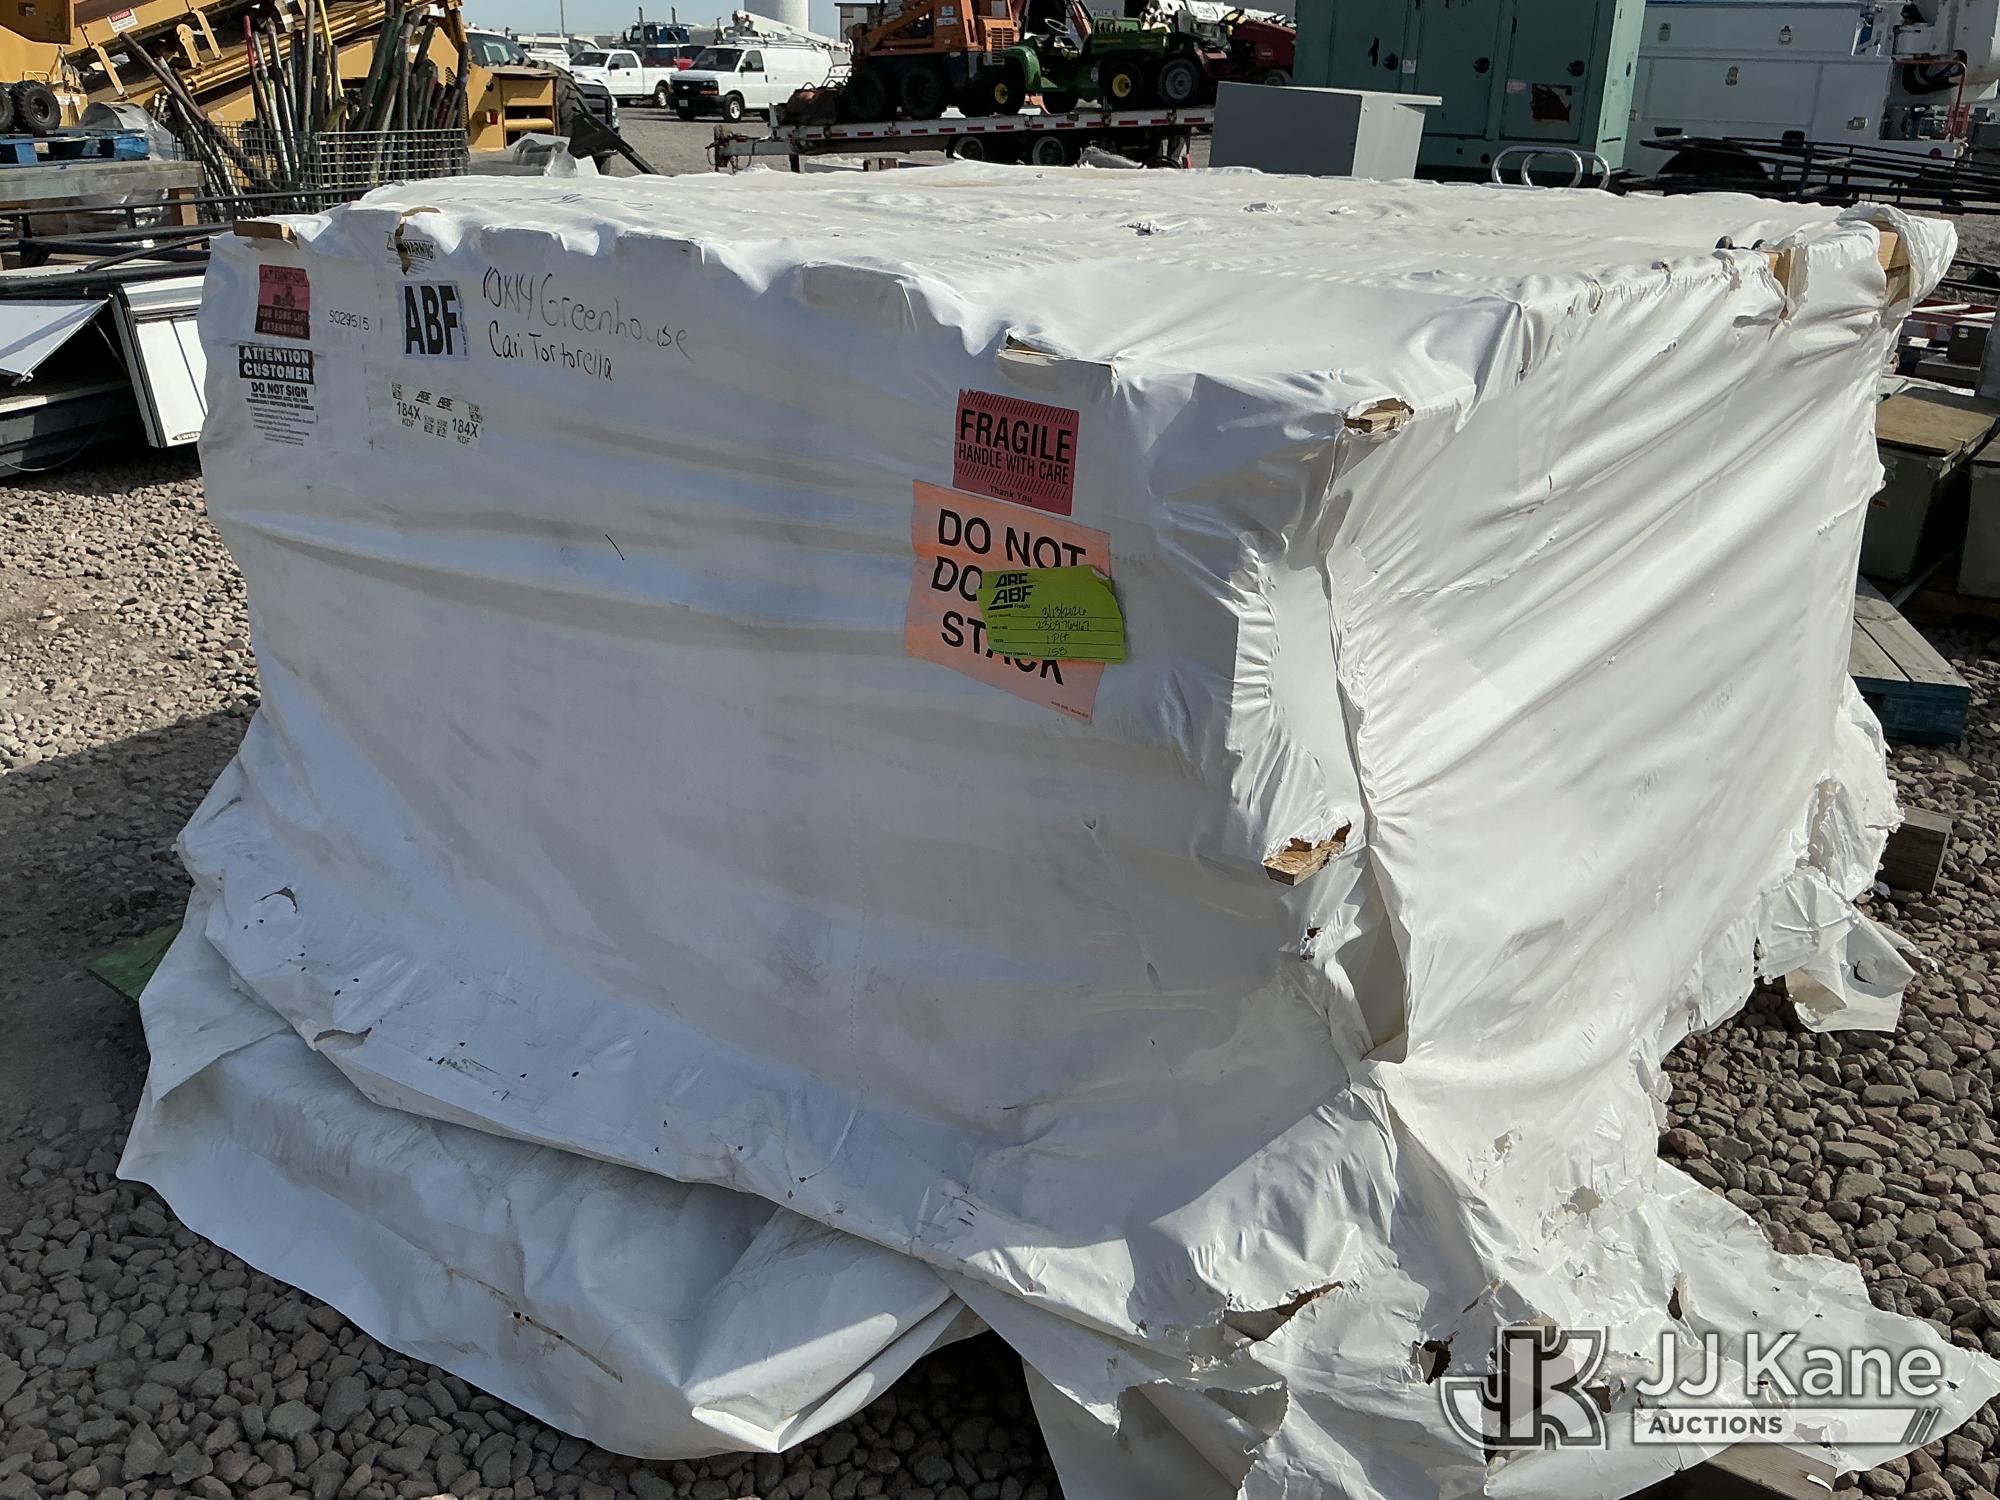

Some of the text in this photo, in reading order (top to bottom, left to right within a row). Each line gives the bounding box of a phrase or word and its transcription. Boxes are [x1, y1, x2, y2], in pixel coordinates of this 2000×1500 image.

[404, 285, 458, 356] ABF
[539, 273, 696, 362] Greenhouse
[243, 346, 310, 364] ATTENTION
[243, 362, 310, 381] CUSTOMER
[251, 381, 265, 393] DO
[267, 383, 284, 396] NOT
[285, 385, 308, 399] SIGN
[396, 401, 421, 421] 184X
[452, 417, 479, 438] 184X
[958, 408, 1073, 465] FRAGILE
[957, 445, 1070, 486] HANDLE WITH CARE
[988, 484, 1034, 504] Thank You
[937, 507, 1087, 569] DO NOT
[990, 585, 1036, 606] ABF
